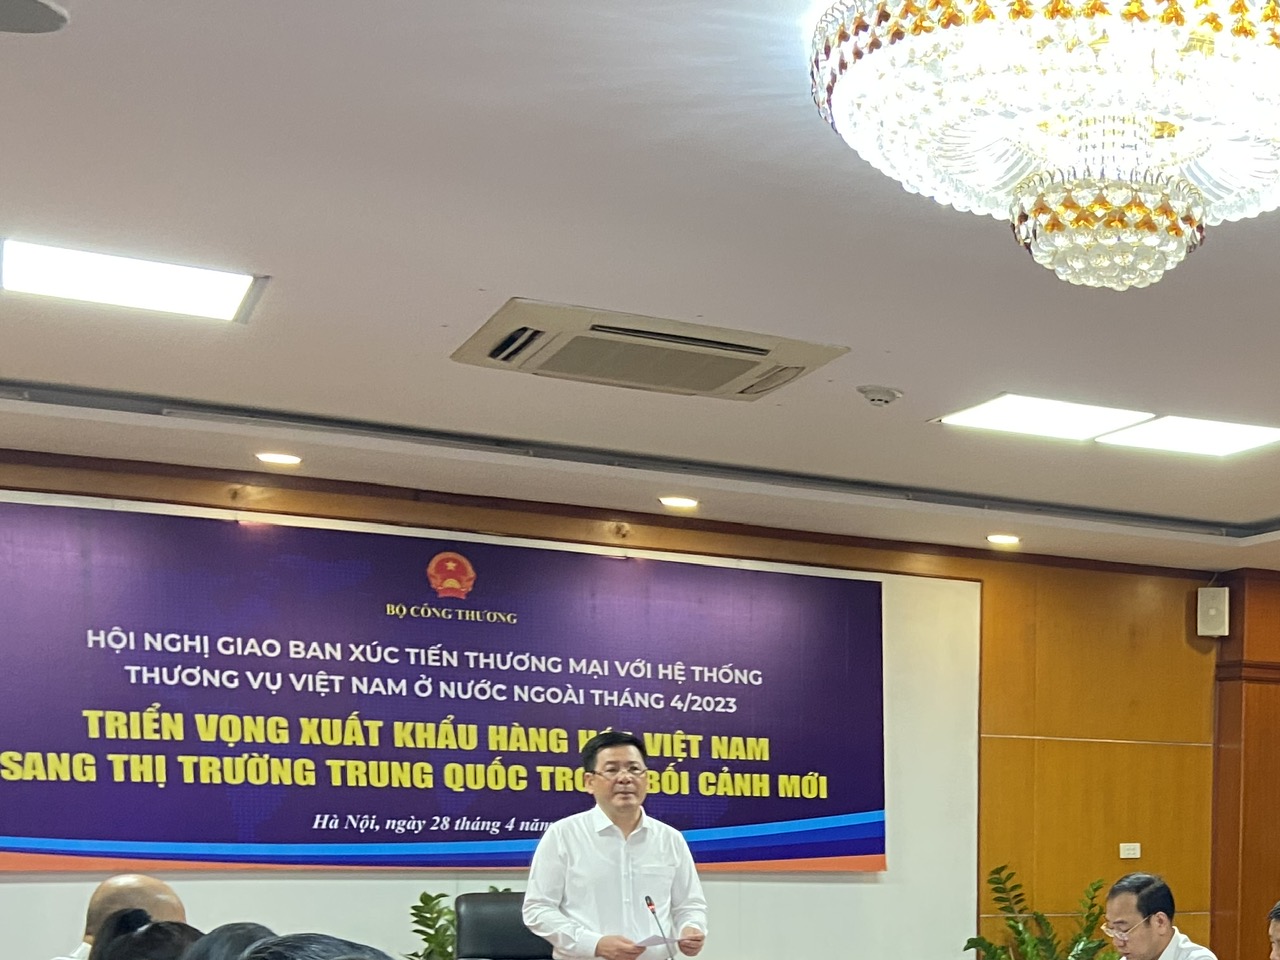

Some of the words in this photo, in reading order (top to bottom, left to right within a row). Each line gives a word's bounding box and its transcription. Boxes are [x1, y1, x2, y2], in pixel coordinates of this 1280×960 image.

[386, 603, 407, 619] BỘ
[410, 603, 452, 619] CÔNG
[455, 609, 517, 624] THƯƠNG
[87, 626, 135, 653] HỘI
[144, 632, 209, 658] NGHỊ
[217, 636, 281, 657] GIAO
[289, 641, 341, 660] BAN
[349, 641, 399, 664] XÚC
[405, 644, 457, 667] TIẾN
[464, 652, 562, 673] THƯƠNG
[569, 657, 608, 679] MẠI
[615, 658, 651, 679] VỚI
[658, 661, 686, 684] HỆ
[691, 663, 763, 685] THỐNG
[125, 664, 239, 688] THƯƠNG
[246, 671, 282, 694] VỤ
[289, 670, 344, 697] VIỆT
[351, 677, 407, 696] NAM
[414, 674, 433, 697] Ở
[439, 679, 507, 700] NƯỚC
[513, 684, 584, 704] NGOÀI
[590, 688, 664, 709] THÁNG
[670, 693, 737, 713] 4/2023
[82, 702, 184, 741] TRIỂN
[195, 714, 289, 747] VỌNG
[299, 711, 383, 747] XUẤT
[393, 714, 478, 750] KHẨU
[488, 722, 568, 753] HÀNG
[643, 730, 703, 762] VIỆT
[711, 736, 769, 761] NAM
[0, 751, 96, 782] SANG
[107, 753, 166, 788] THỊ
[177, 753, 316, 785] TRƯỜNG
[325, 760, 433, 788] TRUNG
[443, 756, 528, 792] QUỐC
[647, 762, 690, 795] BỐI
[698, 766, 770, 797] CẢNH
[778, 771, 828, 799] MỚI
[312, 814, 339, 829] Hà
[344, 814, 380, 833] Nội,
[385, 815, 426, 833] ngày
[430, 816, 450, 831] 28
[454, 816, 501, 834] tháng
[505, 817, 515, 831] 4
